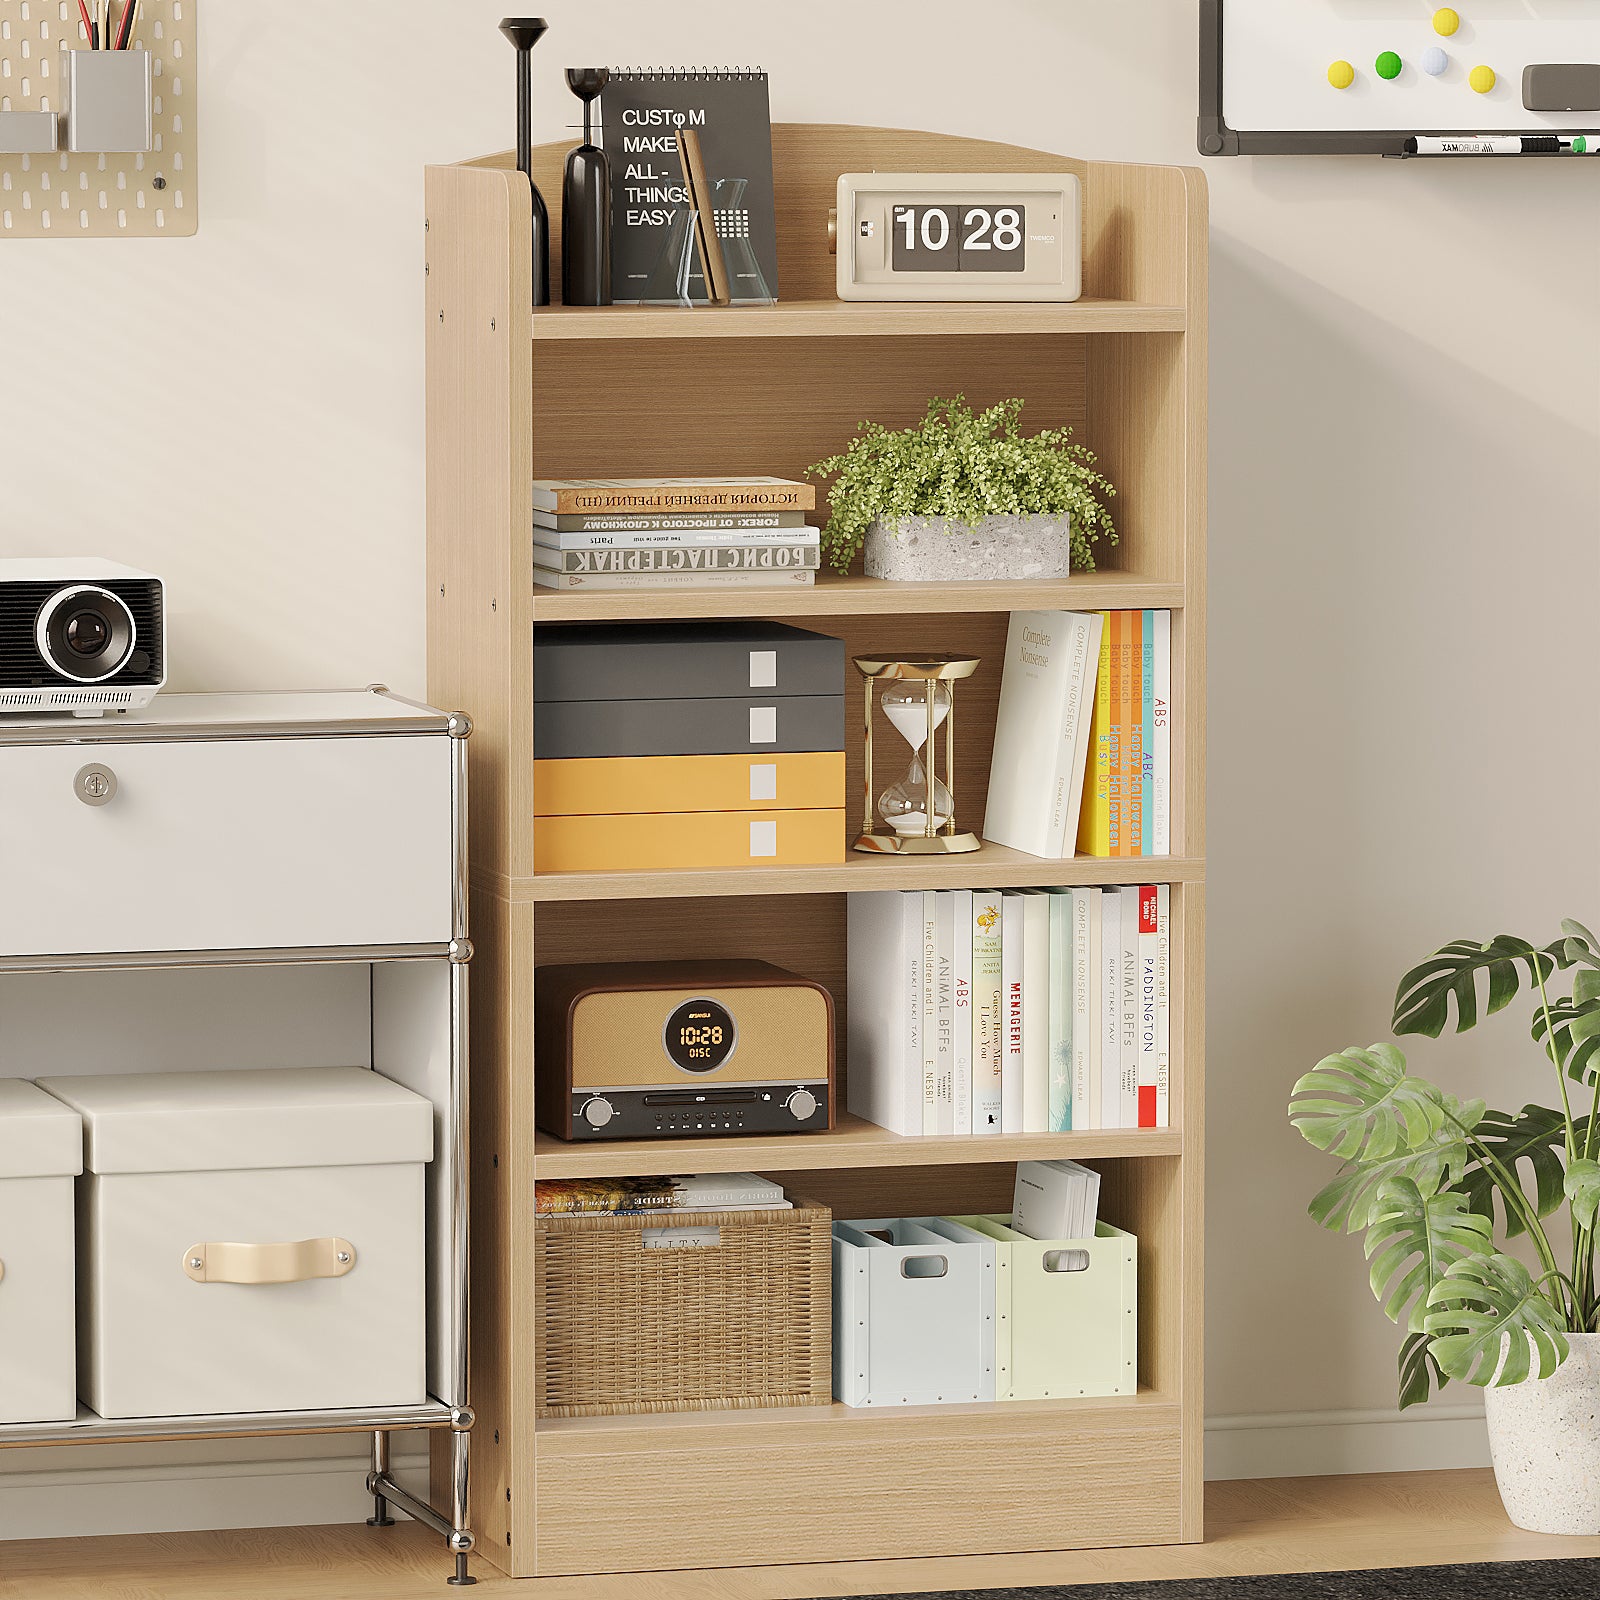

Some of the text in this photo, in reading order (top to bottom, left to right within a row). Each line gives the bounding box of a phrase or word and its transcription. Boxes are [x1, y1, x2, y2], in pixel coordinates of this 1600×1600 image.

[623, 136, 679, 153] MAKE
[624, 163, 659, 180] ALL
[626, 209, 677, 226] EASY
[896, 208, 950, 251] 10
[963, 208, 1022, 251] 28
[606, 494, 662, 507] ГРЕЦИИ
[665, 493, 729, 508] ДРЕВНЕЙ
[730, 493, 798, 505] ИСТОРИЯ
[583, 518, 779, 530] FOREX: ОТ ПРОСТОГО К СЛОЖНОМУ
[590, 537, 613, 545] Paris
[575, 549, 719, 572] ПАСТЕРНАК
[727, 547, 805, 568] БОРИС
[1022, 625, 1051, 647] Complete
[1019, 646, 1049, 668] Nonsense
[1122, 644, 1131, 669] Baby
[1144, 643, 1153, 668] Baby
[1064, 625, 1085, 741] COMPLETE NONSENSE
[1122, 674, 1130, 704] touch
[1098, 644, 1110, 800] Baby touch Busy Day
[1154, 698, 1167, 727] ABS
[1109, 644, 1121, 847] Baby touch Happy Halloween
[1131, 643, 1143, 847] Baby touch Happy Halloween
[1142, 752, 1153, 780] ABC
[1053, 776, 1065, 828] EDWARD LEAR
[1158, 915, 1167, 934] Five
[1158, 938, 1167, 977] Children
[957, 979, 968, 1007] ABS
[1158, 980, 1167, 997] and
[925, 921, 934, 1105] Five Children and It E. NESBIT
[1143, 958, 1154, 1052] PADDINGTON
[980, 1013, 990, 1037] Love
[1010, 982, 1021, 1054] MENAGERIE
[1124, 1013, 1135, 1047] BFFs
[680, 1026, 723, 1045] 10:28
[938, 1019, 949, 1053] BFFs
[992, 990, 1001, 1076] Guess How Much
[981, 1039, 990, 1059] You
[1159, 1052, 1167, 1060] E.
[1159, 1065, 1167, 1097] NESBIT
